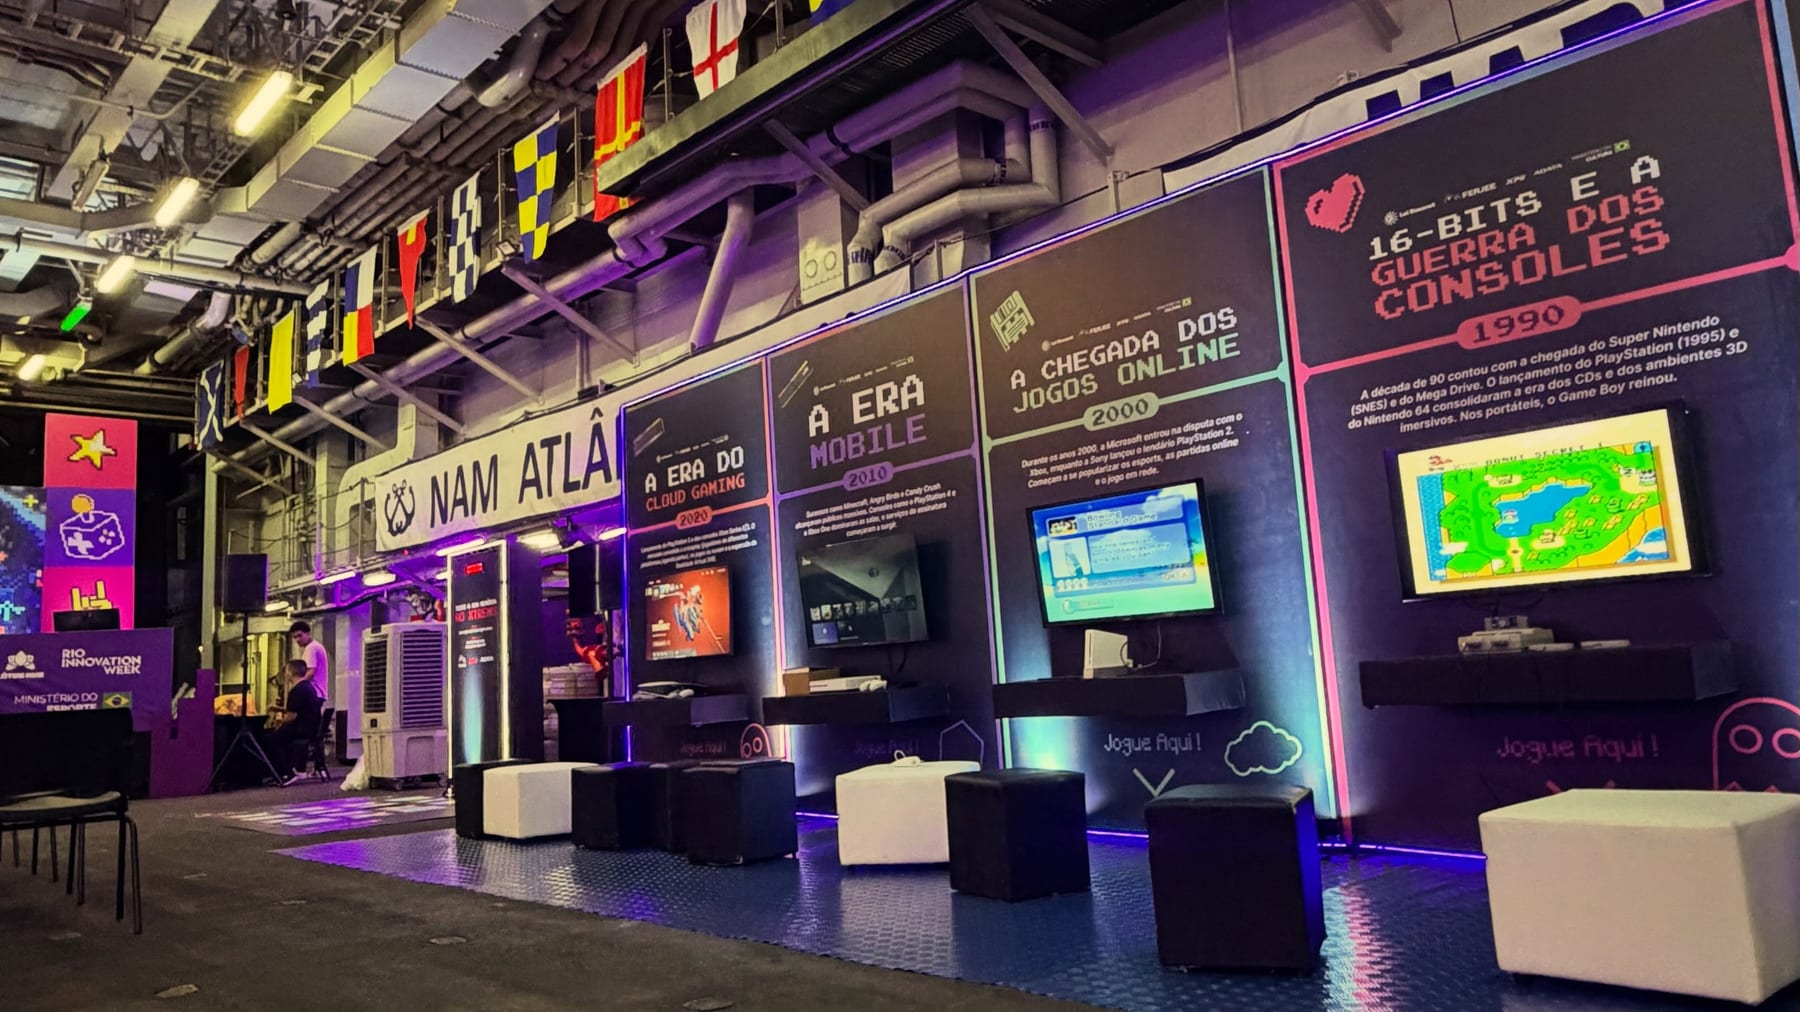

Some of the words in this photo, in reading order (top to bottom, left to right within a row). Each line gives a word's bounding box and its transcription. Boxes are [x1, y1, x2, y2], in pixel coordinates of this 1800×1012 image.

[1369, 190, 1542, 261] 16-BITS
[1570, 172, 1601, 202] E
[1630, 155, 1661, 185] A
[1461, 182, 1497, 199] FERJEE
[1371, 222, 1537, 287] GUERRA
[1566, 185, 1665, 235] DOS
[1374, 217, 1670, 320] CONSOLES
[1472, 303, 1566, 344] 1990
[1010, 369, 1026, 390] A
[1040, 330, 1160, 381] CHEGADA
[1177, 306, 1238, 342] DOS
[1360, 389, 1369, 400] A
[1371, 382, 1411, 399] década
[1413, 377, 1427, 390] de
[1429, 373, 1445, 386] 90
[1447, 367, 1488, 382] contou
[1491, 361, 1517, 373] com
[1519, 358, 1528, 367] a
[1531, 343, 1585, 364] chegada
[1588, 340, 1606, 355] do
[1609, 330, 1650, 348] Super
[1653, 315, 1720, 339] Nintendo
[1013, 373, 1098, 414] JOGOS
[1117, 332, 1240, 386] ONLINE
[1348, 417, 1362, 430] do
[1364, 408, 1412, 427] Nintendo
[1415, 406, 1430, 417] 64
[1432, 387, 1511, 413] consolidaram
[1514, 386, 1522, 395] a
[1524, 381, 1545, 394] era
[1547, 375, 1571, 391] dos
[1574, 370, 1602, 384] CDs
[1605, 370, 1613, 379] e
[1617, 361, 1642, 377] dos
[1645, 347, 1722, 372] ambientes
[1726, 341, 1748, 355] 3D
[1350, 399, 1387, 417] (SNES)
[1390, 399, 1397, 408] e
[1399, 394, 1414, 406] do
[1416, 389, 1447, 404] Mega
[1450, 380, 1484, 395] Drive.
[1486, 376, 1496, 388] O
[1499, 363, 1571, 385] lançamento
[1575, 357, 1592, 370] do
[1595, 342, 1674, 366] PlayStation
[1677, 328, 1726, 350] (1995)
[1729, 327, 1740, 339] e
[808, 404, 830, 437] A
[852, 374, 925, 425] ERA
[1091, 399, 1149, 427] 2000
[1400, 416, 1457, 433] imersivos.
[1459, 410, 1483, 422] Nos
[1485, 397, 1545, 418] portáteis,
[1547, 396, 1556, 405] o
[1558, 388, 1597, 402] Game
[1600, 381, 1626, 396] Boy
[1629, 373, 1678, 390] reinou.
[810, 413, 927, 469] MOBILE
[1059, 450, 1076, 460] anos
[1106, 434, 1142, 450] Microsoft
[1143, 429, 1170, 441] entrou
[1171, 426, 1182, 436] na
[1183, 419, 1214, 432] disputa
[1215, 415, 1235, 425] com
[1236, 412, 1244, 421] o
[1090, 454, 1109, 465] Sony
[1176, 429, 1224, 446] PlayStation
[1225, 425, 1235, 436] 2.
[430, 454, 498, 528] NAM
[518, 407, 621, 505] ATLÂ
[645, 472, 657, 493] A
[667, 458, 705, 487] ERA
[716, 445, 745, 474] DO
[850, 466, 888, 487] 2010
[1078, 463, 1120, 479] popularizar
[1120, 461, 1131, 469] os
[1165, 452, 1176, 460] as
[1176, 444, 1211, 459] partidas
[1212, 438, 1239, 451] online
[1107, 473, 1125, 485] jogo
[1125, 471, 1138, 479] em
[646, 489, 686, 511] CLOUD
[691, 472, 745, 500] GAMING
[679, 510, 709, 526] 2020
[61, 648, 85, 659] RIO
[61, 656, 141, 669] INNOVATION
[104, 665, 141, 675] WEEK
[14, 692, 79, 704] MINISTÉRIO
[81, 692, 98, 702] DO
[1104, 733, 1151, 757] Jogue
[1156, 733, 1193, 755] Aqui
[1497, 735, 1575, 764] Jogue
[1583, 735, 1644, 763] Aqui
